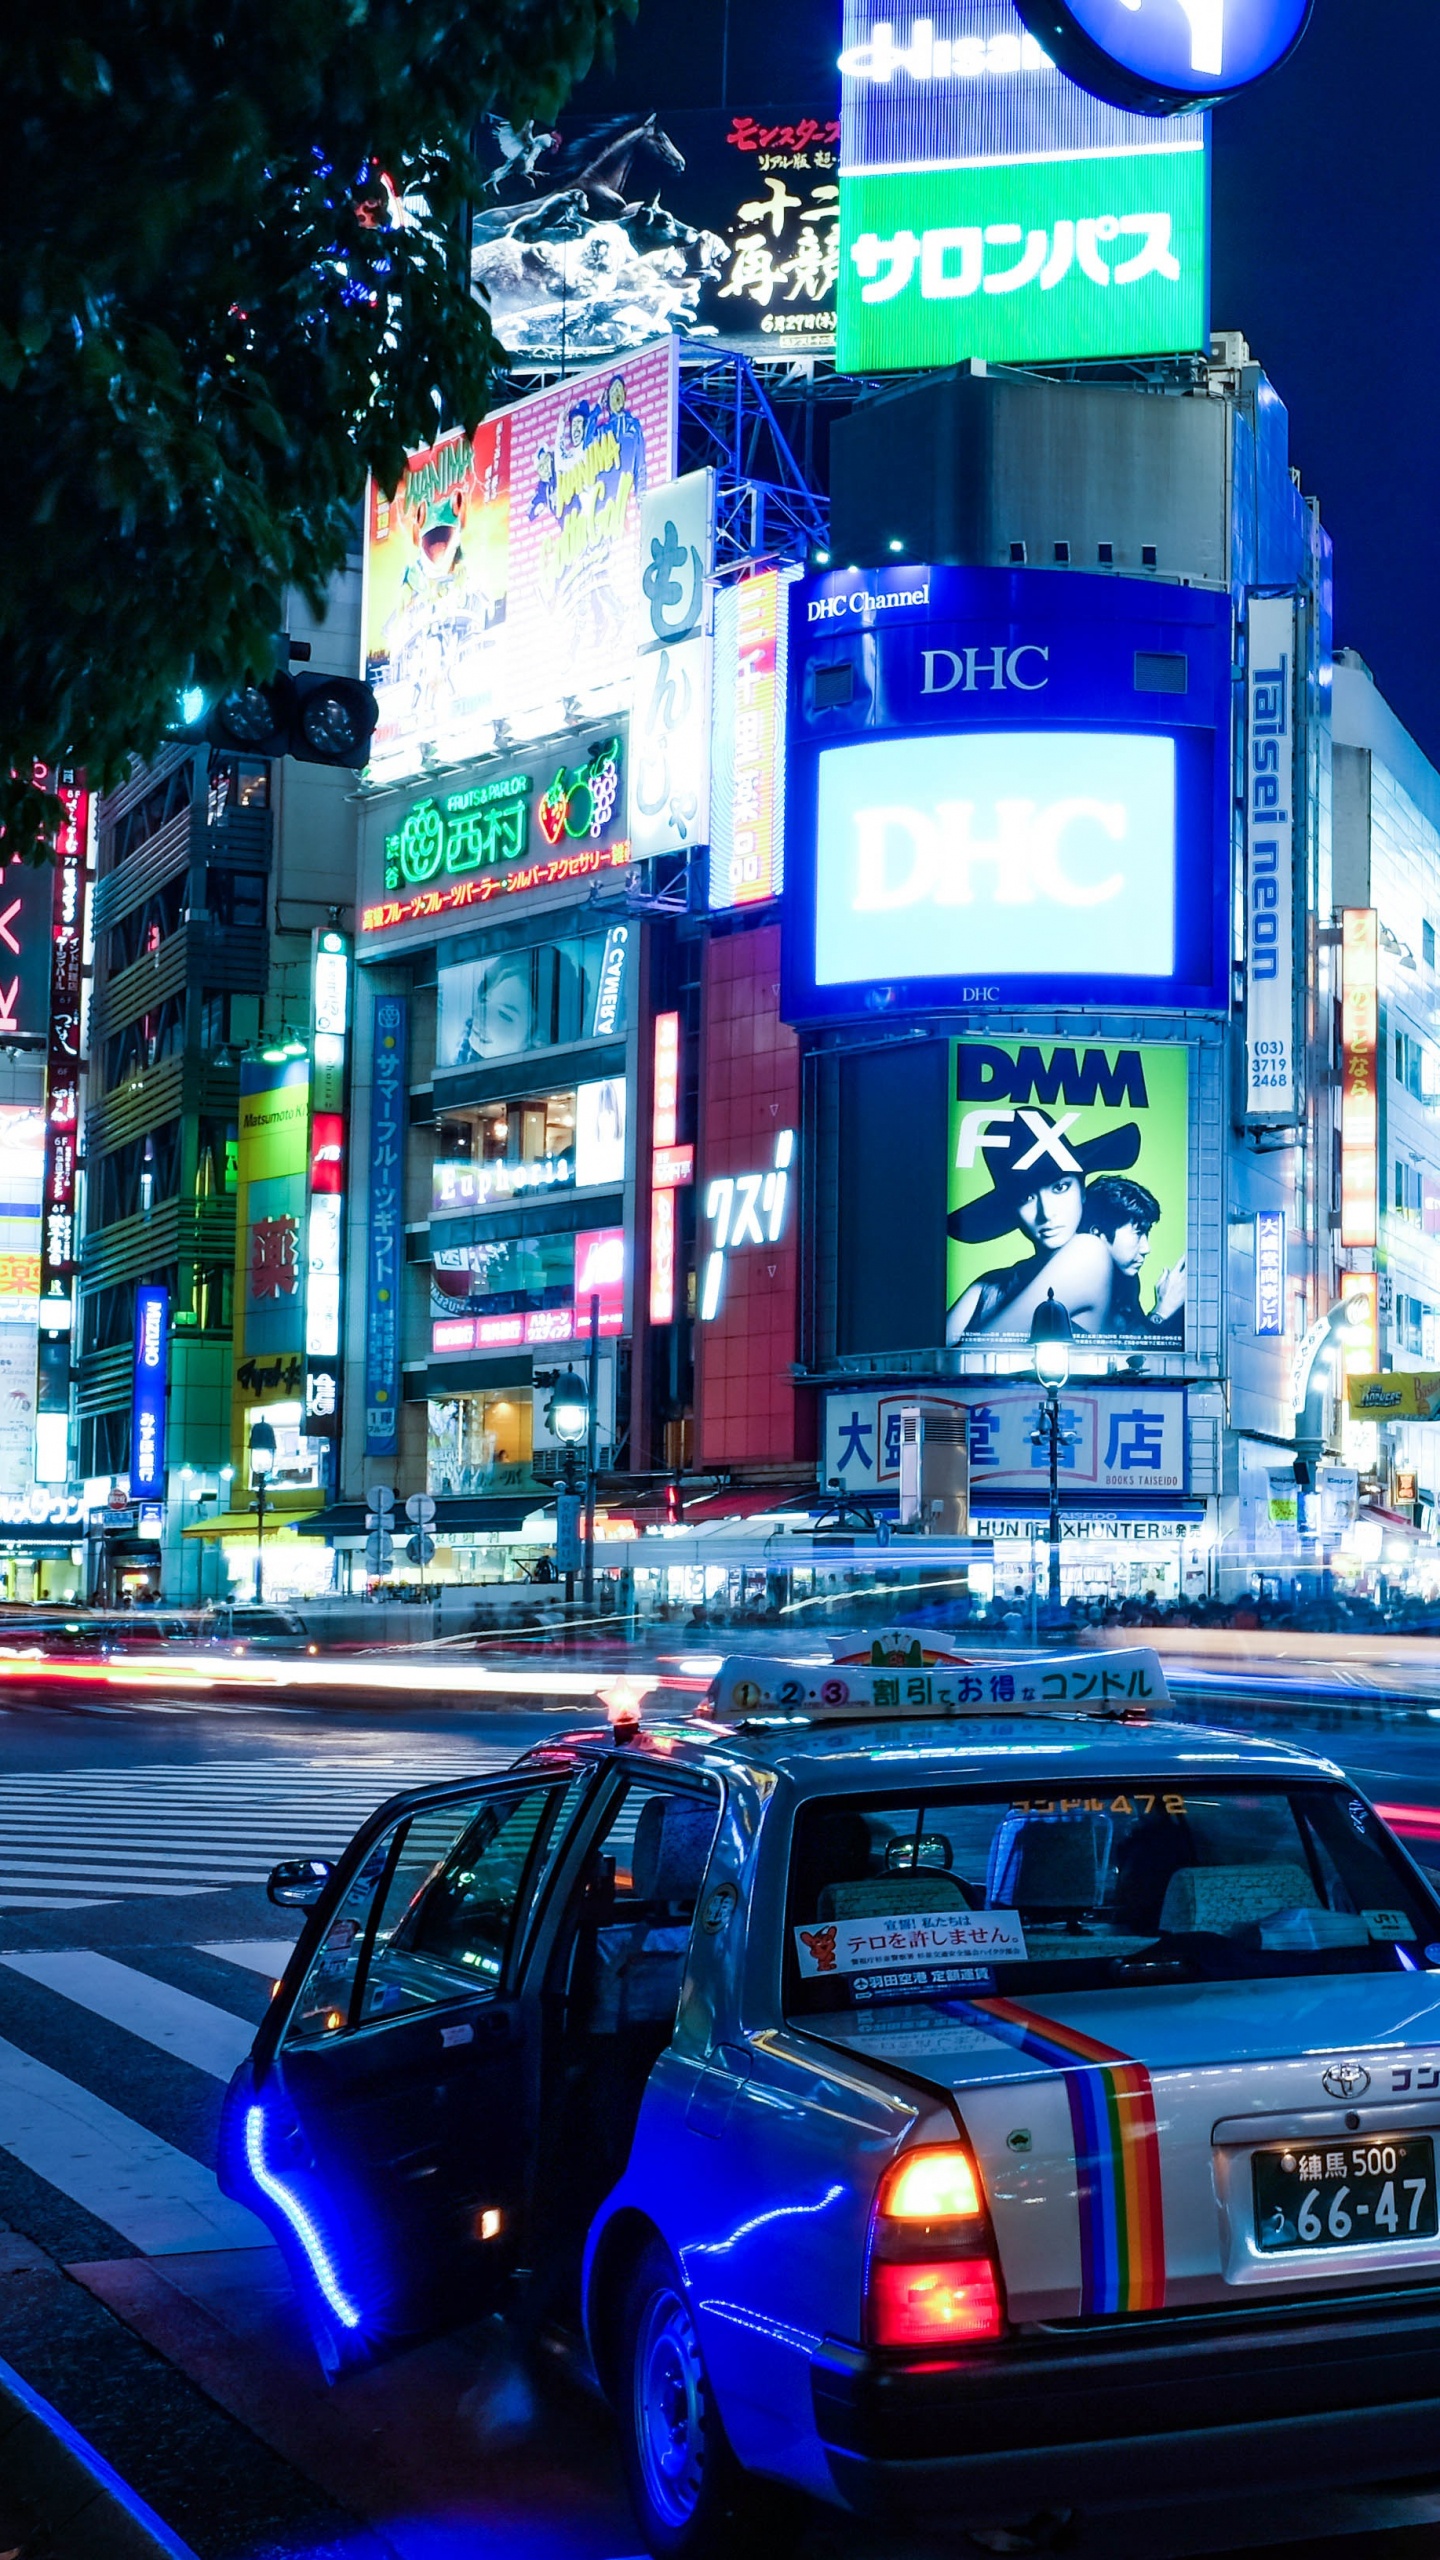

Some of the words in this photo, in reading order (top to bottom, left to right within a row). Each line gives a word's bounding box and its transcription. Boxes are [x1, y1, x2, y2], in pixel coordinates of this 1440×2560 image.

[851, 213, 1180, 303] サロンパス
[557, 430, 621, 518] WANIMA
[807, 600, 847, 622] DHC
[849, 586, 930, 612] Channel
[637, 520, 704, 839] もんじゃ
[921, 645, 1049, 694] DHC
[1252, 652, 1288, 825] Taisei
[447, 800, 527, 874] 西村
[851, 796, 1126, 912] DHC
[385, 835, 400, 889] 渋谷
[1252, 840, 1280, 982] neon
[962, 987, 1000, 1002] DHC
[1252, 1058, 1287, 1072] 3719
[1254, 1040, 1284, 1055] (03)
[957, 1043, 1149, 1108] DMM
[1252, 1073, 1287, 1088] 2468
[243, 1107, 294, 1128] Matsumoto
[54, 1137, 68, 1146] 6F
[956, 1109, 1084, 1172] FX
[374, 1054, 400, 1282] サマーフルーツギフト
[440, 1158, 569, 1204] Euphoria
[52, 1204, 66, 1213] 6F
[252, 1214, 299, 1299] 薬
[145, 1302, 162, 1367] MIZUHO
[1106, 1475, 1135, 1486] BOOKS
[1138, 1475, 1178, 1487] TAISEIDO
[1270, 1476, 1296, 1486] Enjoy
[1327, 1477, 1354, 1486] Enjoy
[1057, 1512, 1118, 1521] AISEIDO
[848, 1927, 1019, 1954] テロを許しません。
[922, 1915, 972, 1927] 私たちは
[869, 1970, 928, 1988] 羽田空港
[1298, 2152, 1348, 2181] 練馬
[1352, 2146, 1397, 2177] 500
[1297, 2177, 1427, 2242] 66-47
